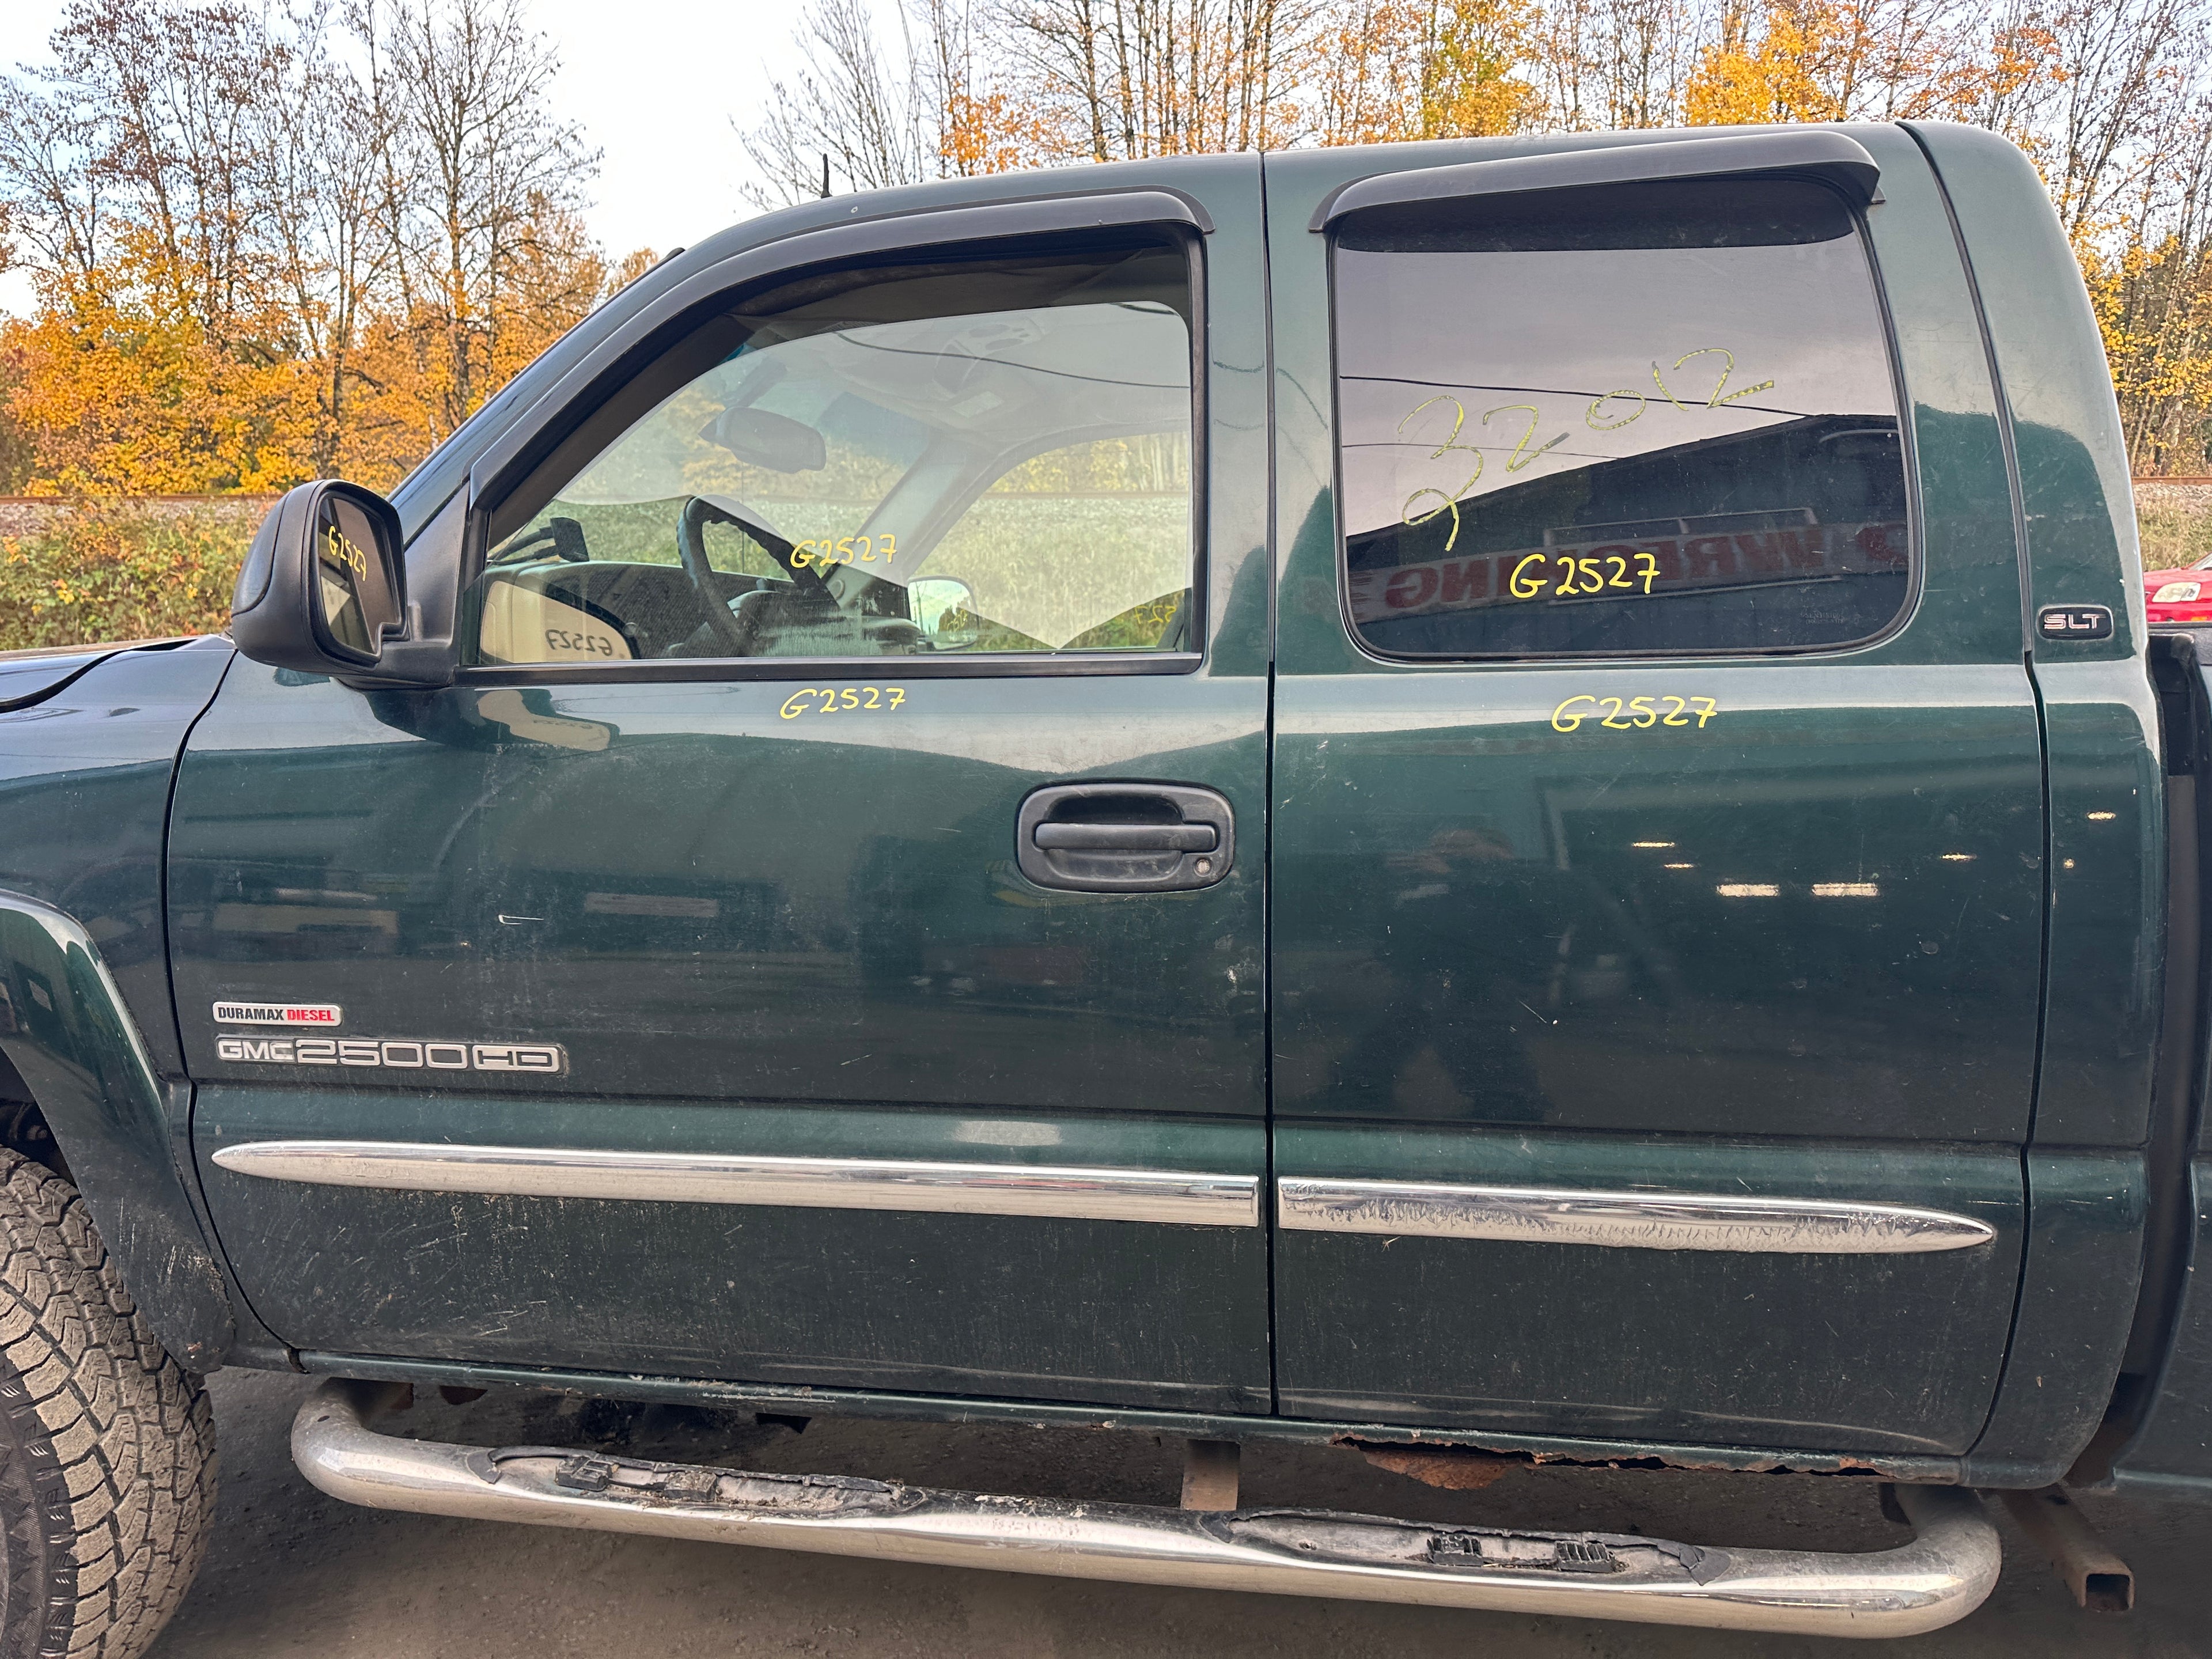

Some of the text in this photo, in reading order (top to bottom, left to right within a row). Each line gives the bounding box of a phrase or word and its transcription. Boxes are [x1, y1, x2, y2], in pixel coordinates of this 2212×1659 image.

[328, 525, 367, 582] G2527
[790, 533, 897, 568] G2527
[1509, 552, 1660, 599] G2527
[2044, 613, 2106, 630] SLT
[779, 686, 906, 719] G2527
[1551, 695, 1718, 733] G2527
[217, 1007, 336, 1022] DURAMAX DIESEL
[217, 1039, 294, 1060] GMC
